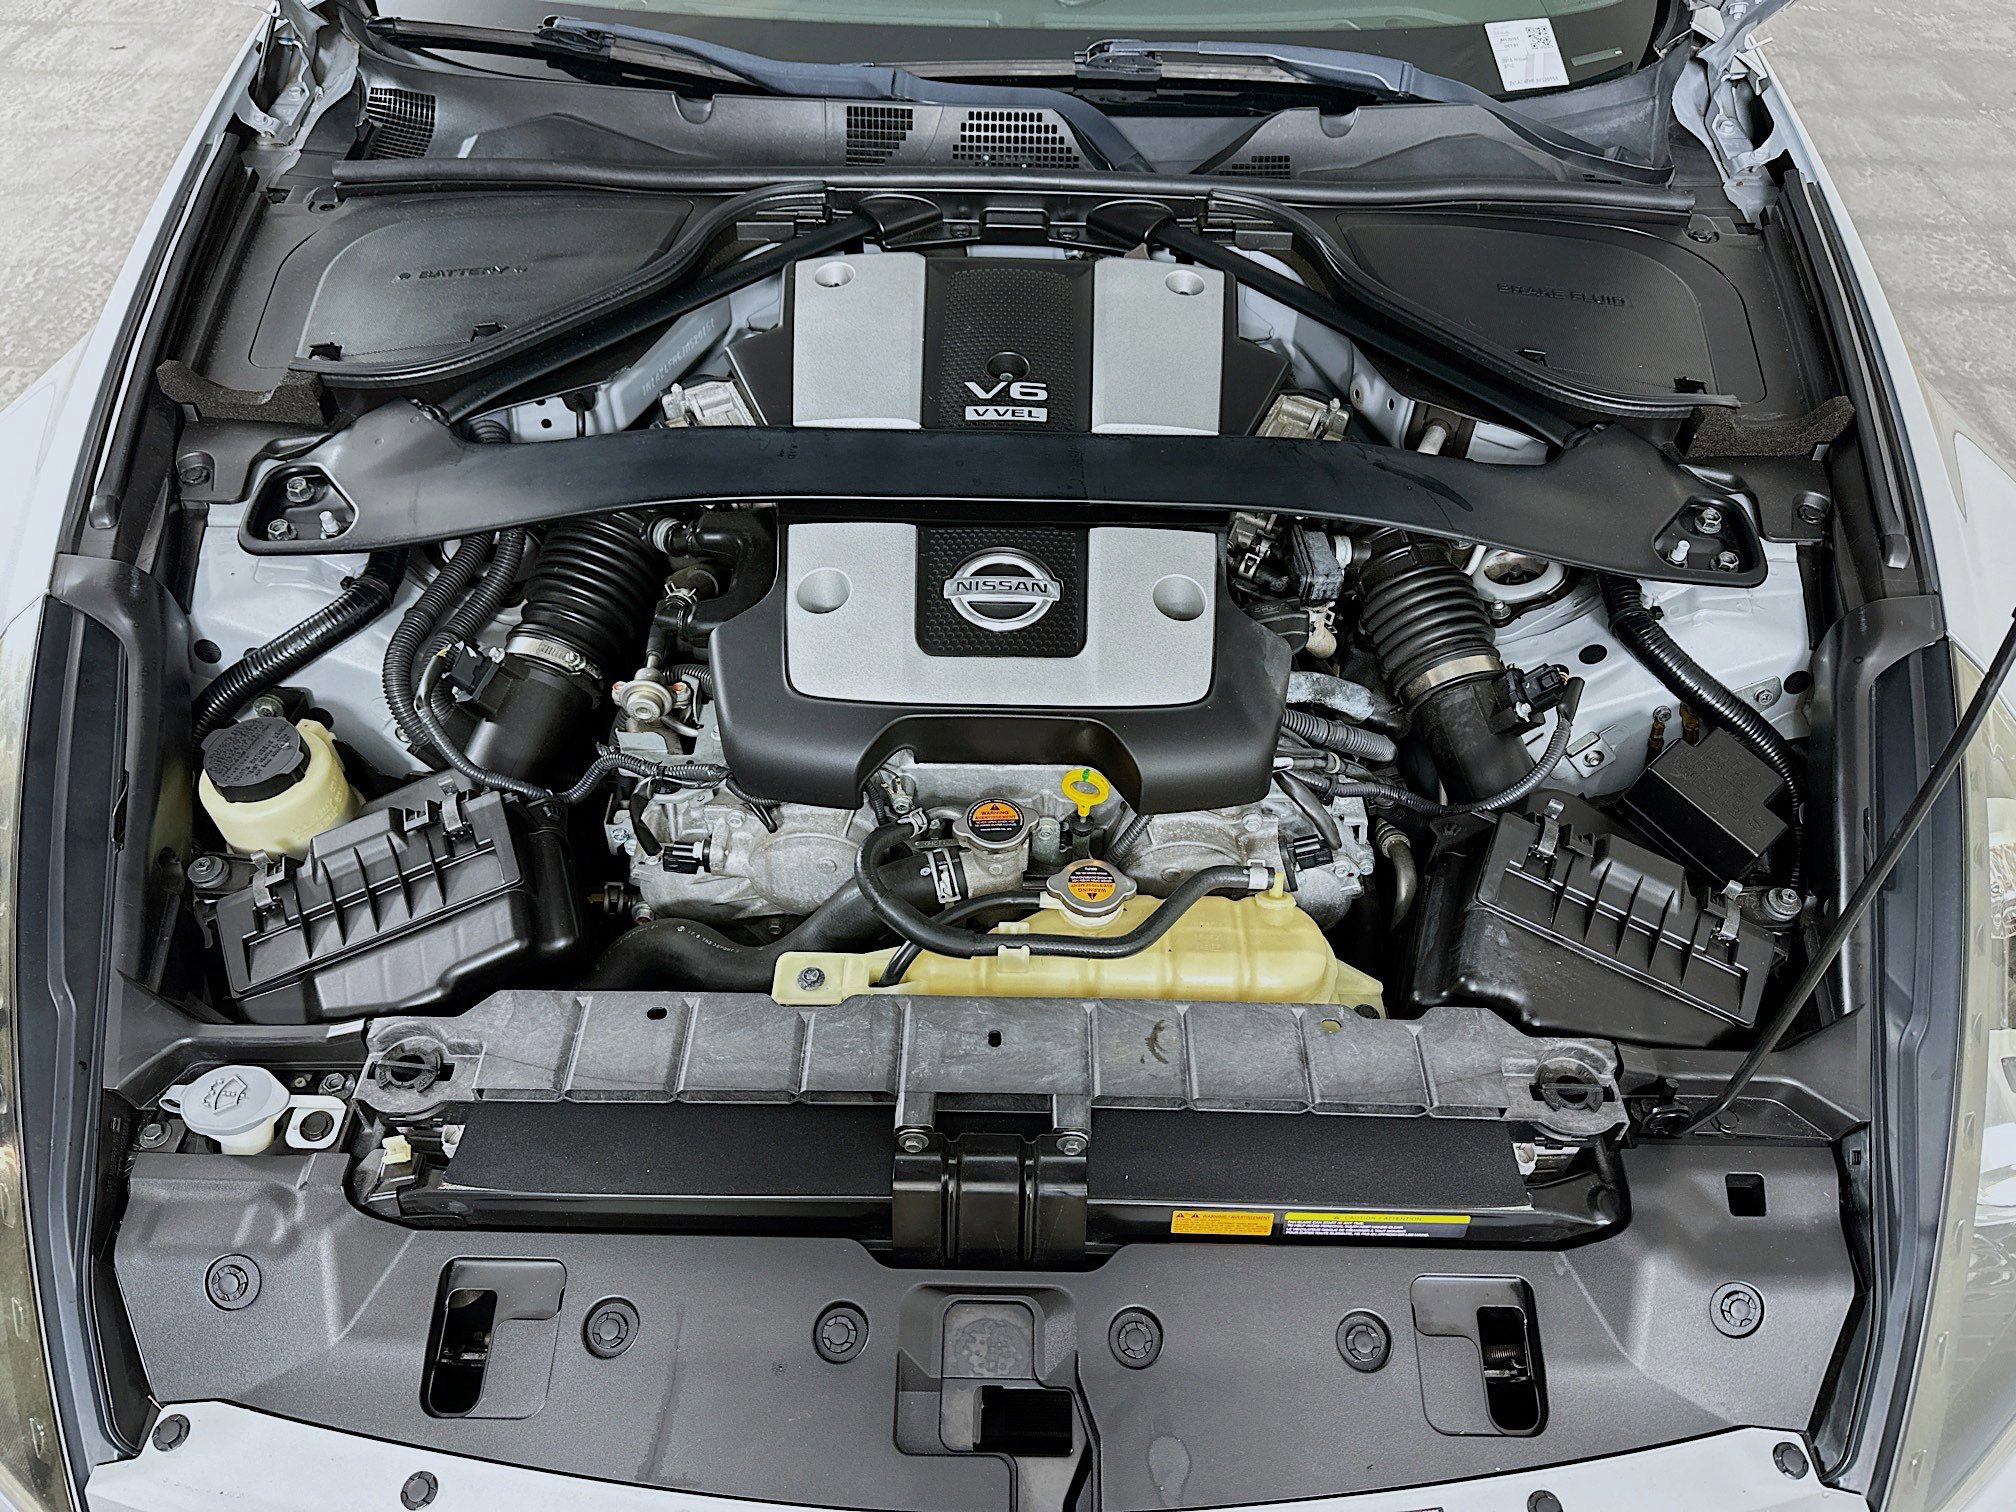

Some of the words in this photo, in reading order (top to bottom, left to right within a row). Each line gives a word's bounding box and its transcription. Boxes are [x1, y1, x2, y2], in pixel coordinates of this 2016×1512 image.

[419, 265, 510, 279] BATTERY
[1497, 283, 1565, 299] BRAKE
[1570, 291, 1626, 307] FLUID
[964, 381, 1048, 401] V6
[973, 408, 1040, 419] VVEL
[956, 580, 1048, 594] NISSAN
